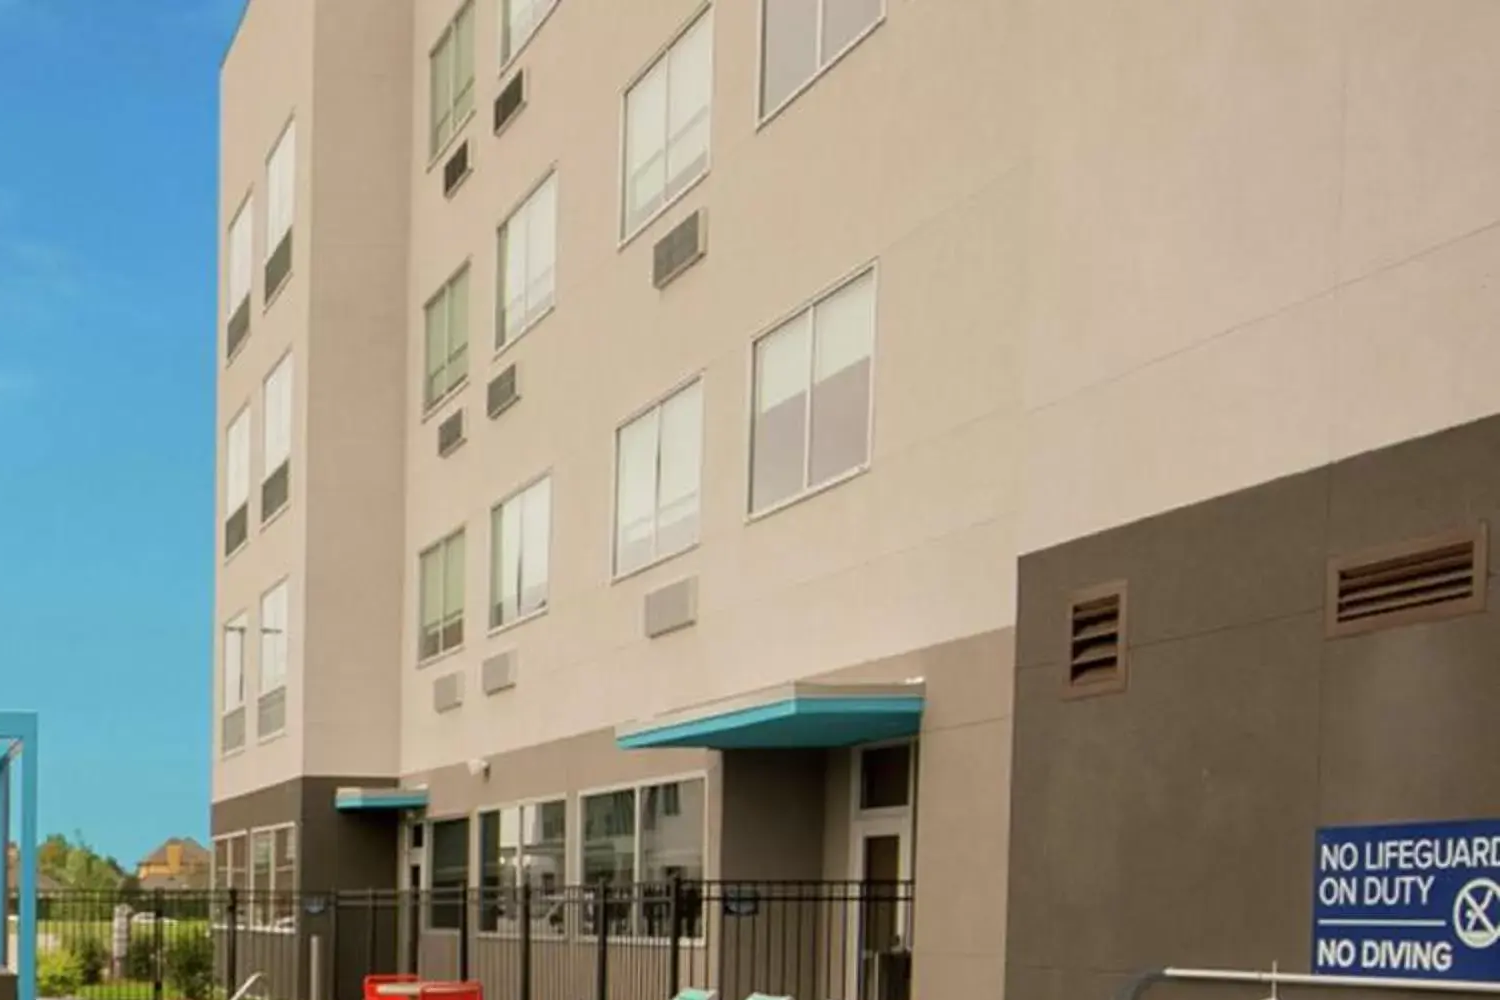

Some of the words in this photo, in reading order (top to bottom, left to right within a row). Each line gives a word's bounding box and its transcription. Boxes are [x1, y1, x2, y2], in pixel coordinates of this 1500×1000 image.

[1321, 842, 1359, 872] NO
[1318, 876, 1357, 906] ON
[1363, 875, 1435, 905] DUTY
[1316, 939, 1356, 967] NO
[1361, 940, 1453, 971] DIVING
